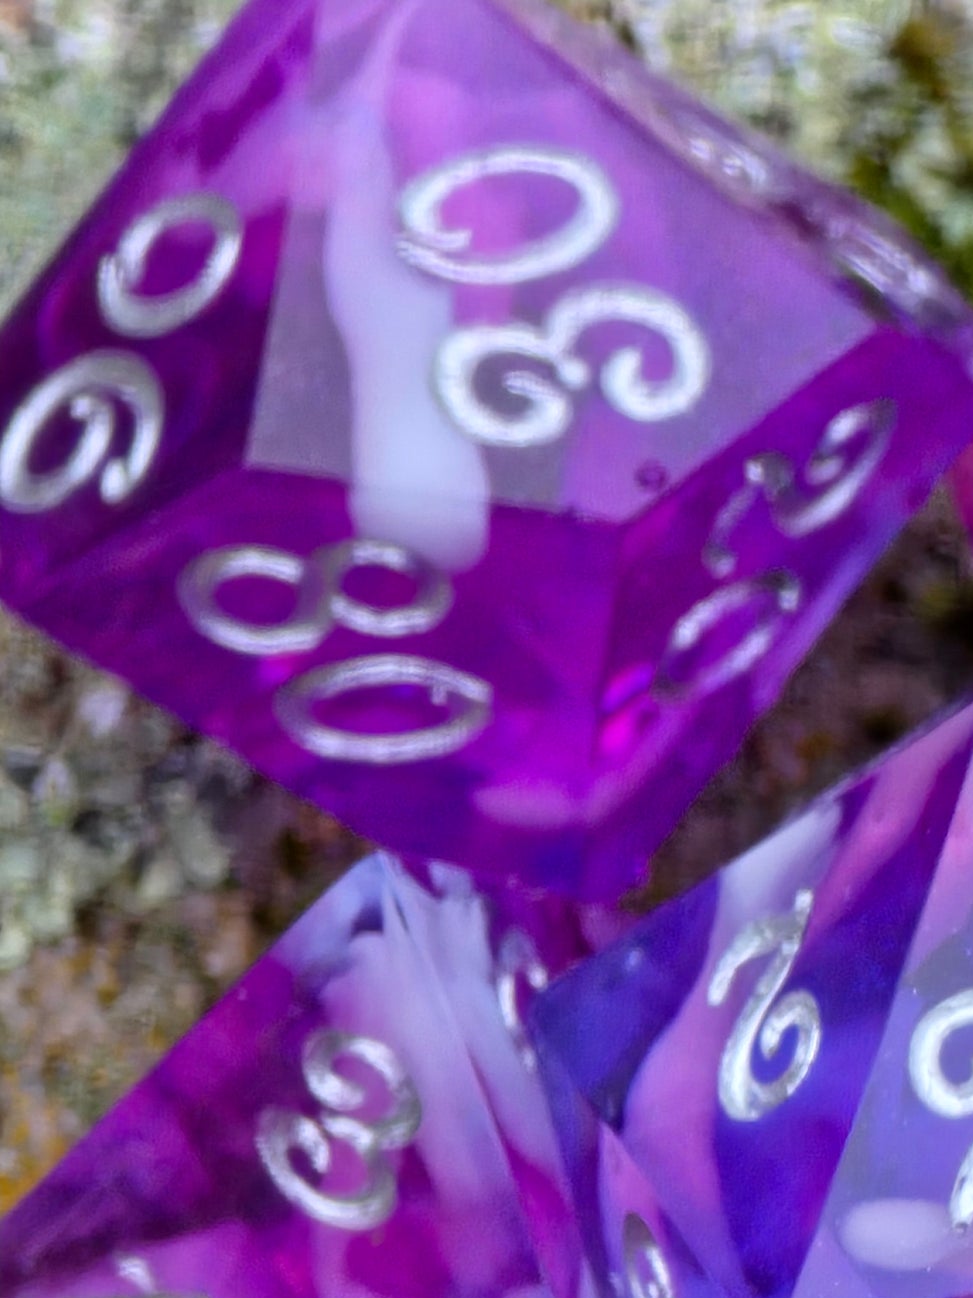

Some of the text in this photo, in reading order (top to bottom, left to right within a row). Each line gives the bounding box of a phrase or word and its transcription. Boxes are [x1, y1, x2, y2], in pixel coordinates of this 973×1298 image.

[400, 145, 712, 446] 30
[178, 538, 494, 764] 80
[256, 1029, 423, 1232] 3
